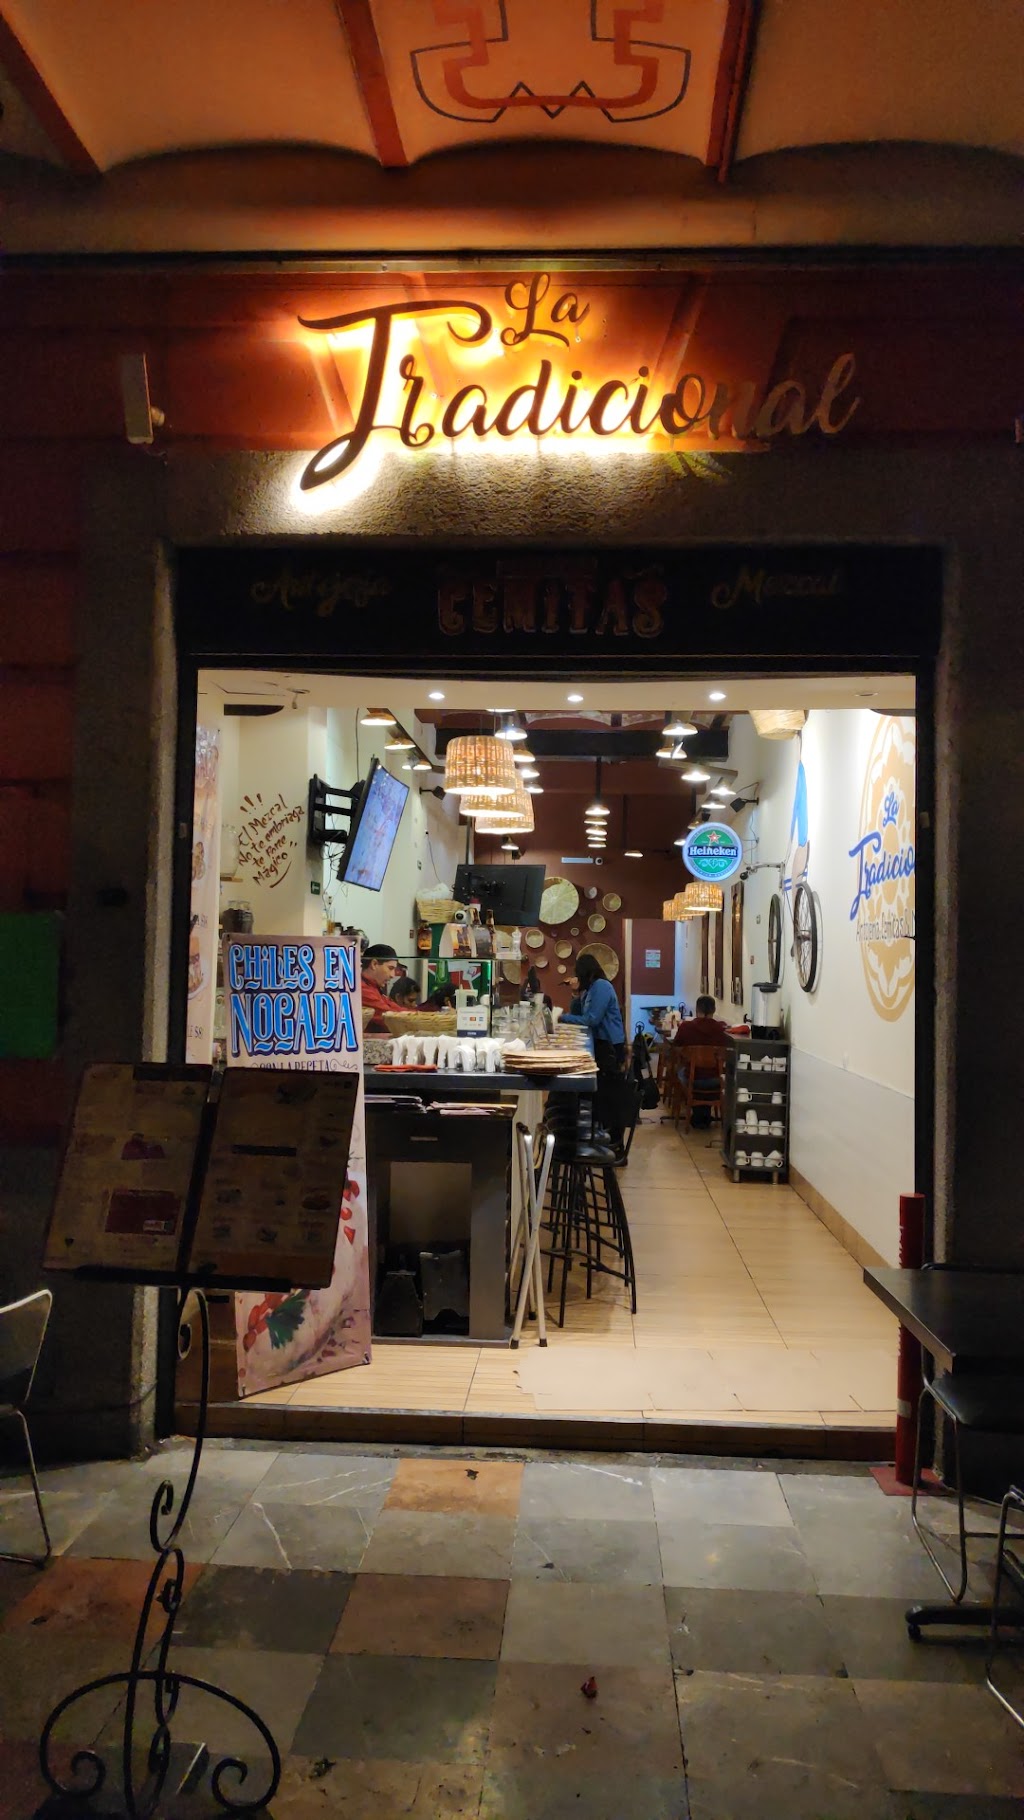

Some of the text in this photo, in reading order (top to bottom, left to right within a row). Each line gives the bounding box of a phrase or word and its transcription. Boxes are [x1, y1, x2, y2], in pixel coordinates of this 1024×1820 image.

[500, 272, 591, 348] La
[296, 299, 861, 492] Tradicional
[248, 793, 288, 835] Mezcal
[265, 805, 305, 842] embriaga
[882, 791, 899, 828] La
[689, 845, 737, 856] Heineken
[849, 831, 916, 921] Tradicio
[229, 944, 355, 992] CHILES EN
[230, 992, 358, 1057] NOGADA
